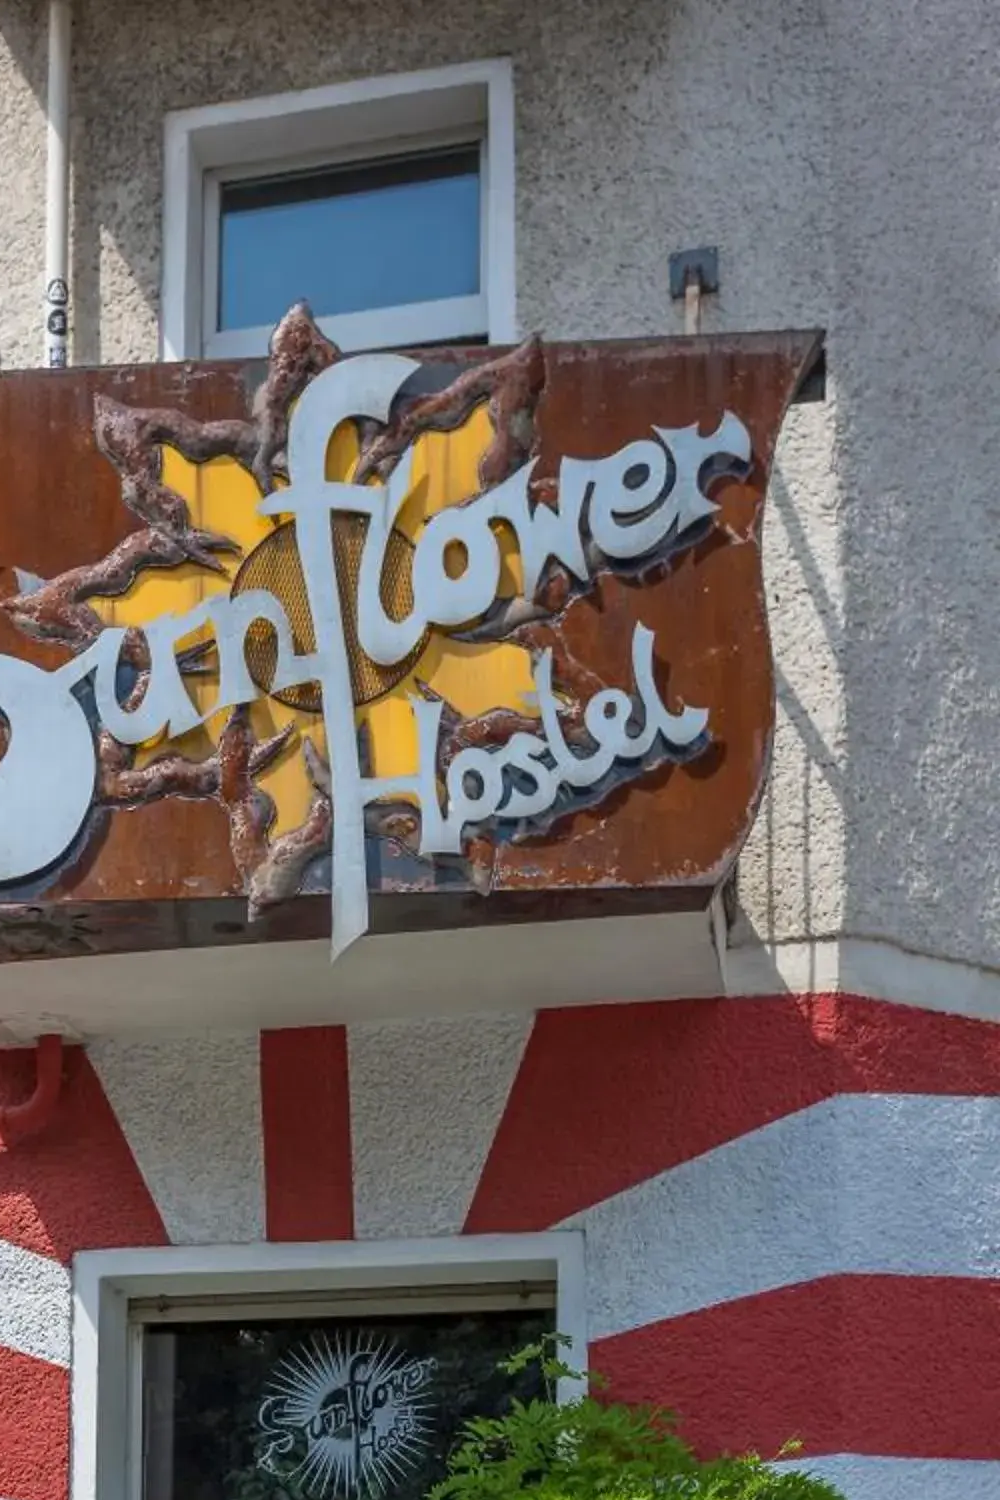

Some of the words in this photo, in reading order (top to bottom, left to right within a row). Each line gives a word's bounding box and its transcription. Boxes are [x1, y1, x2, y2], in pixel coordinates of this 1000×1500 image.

[358, 621, 710, 856] Hostel
[255, 1351, 439, 1485] Sunflower
[359, 1406, 425, 1460] Hostel
